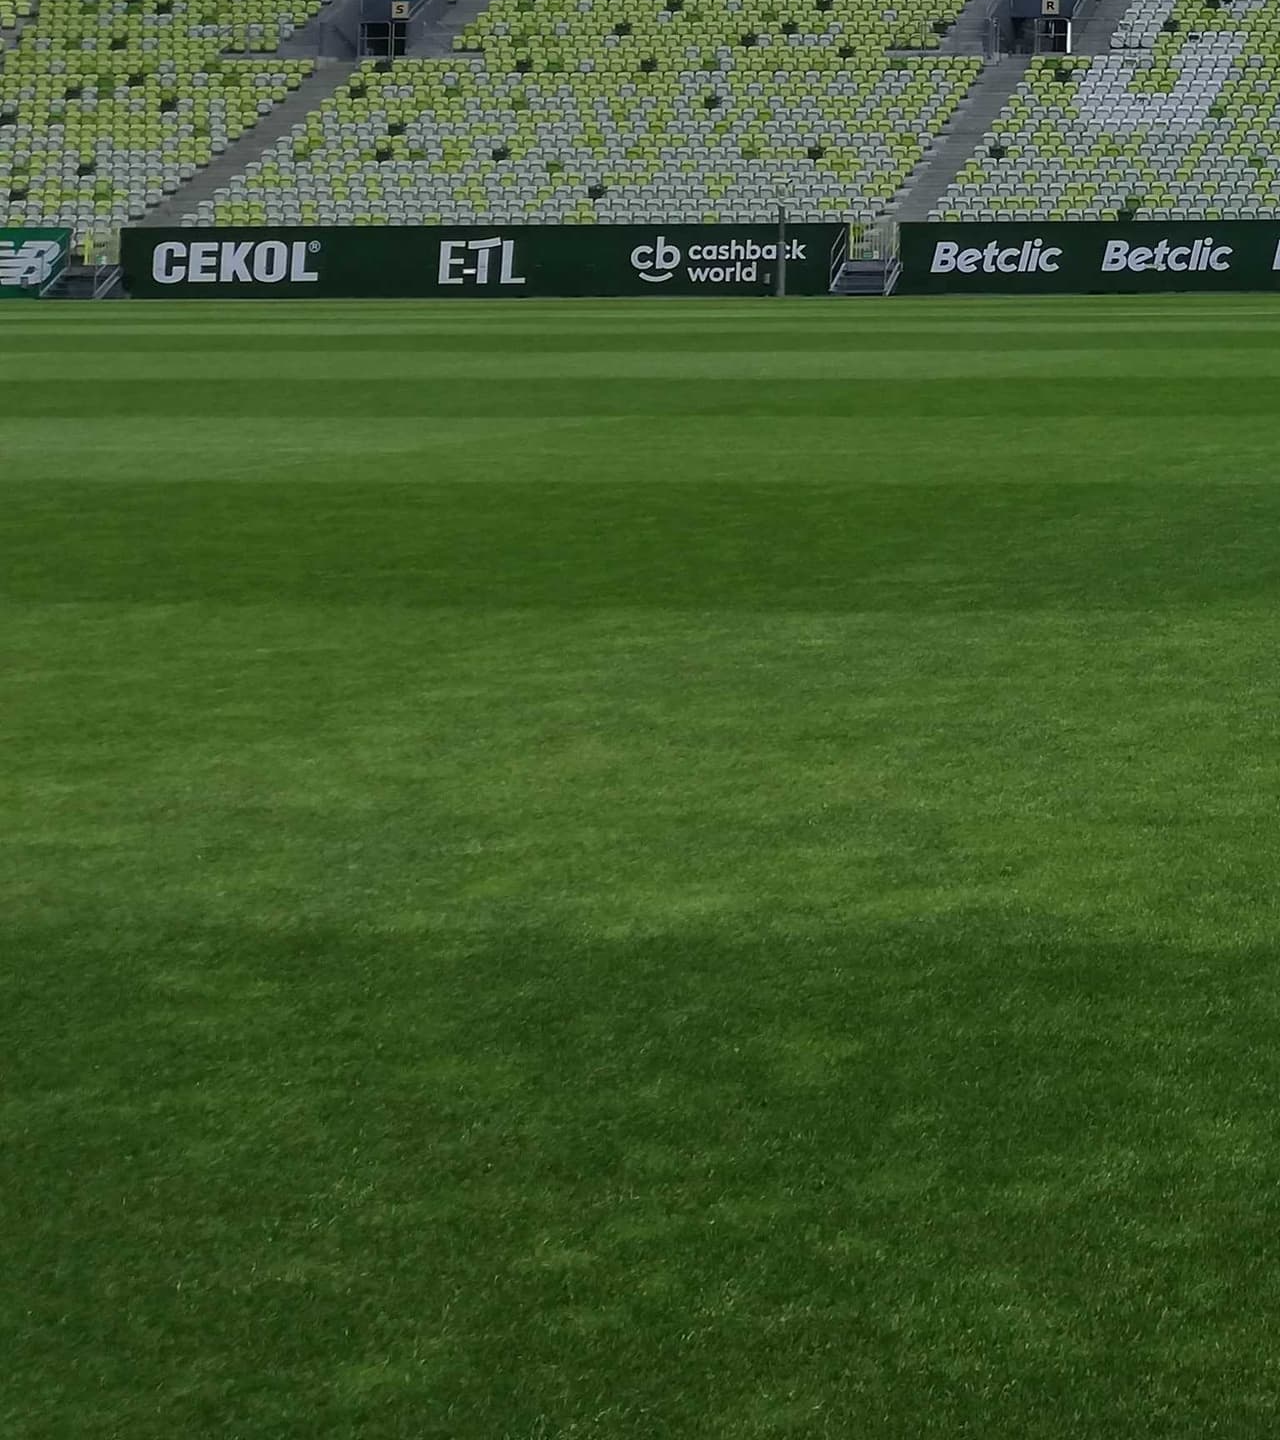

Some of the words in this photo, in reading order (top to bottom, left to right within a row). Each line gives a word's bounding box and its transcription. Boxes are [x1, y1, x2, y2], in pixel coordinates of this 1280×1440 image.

[438, 237, 526, 285] ETL
[630, 236, 681, 270] cb
[930, 238, 1063, 273] Betclic
[1101, 237, 1233, 272] Betclic
[687, 261, 757, 282] world
